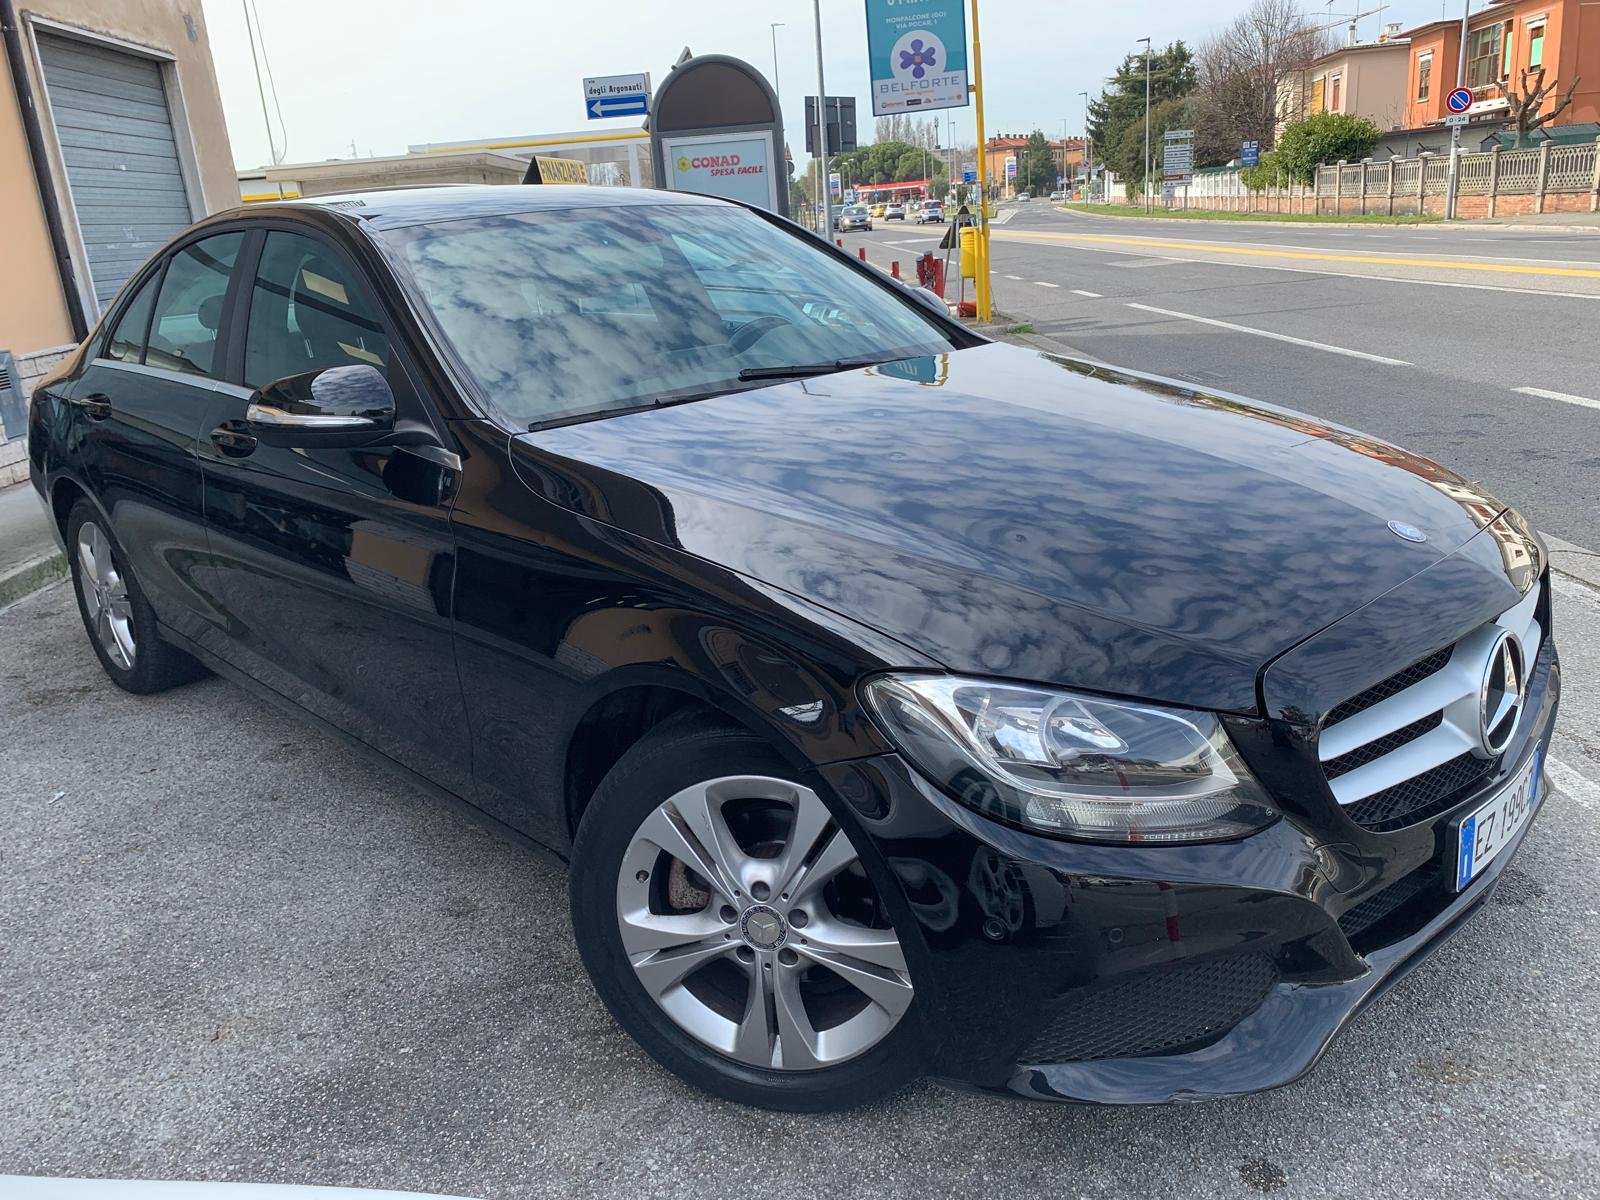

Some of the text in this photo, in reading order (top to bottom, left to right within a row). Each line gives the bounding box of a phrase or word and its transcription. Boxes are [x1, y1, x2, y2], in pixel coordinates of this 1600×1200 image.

[589, 82, 643, 96] degli Argonauti
[880, 76, 960, 93] BELFORTE
[691, 154, 741, 169] CONAD
[710, 165, 765, 177] SPESA FACILE
[1475, 811, 1496, 863] EZ
